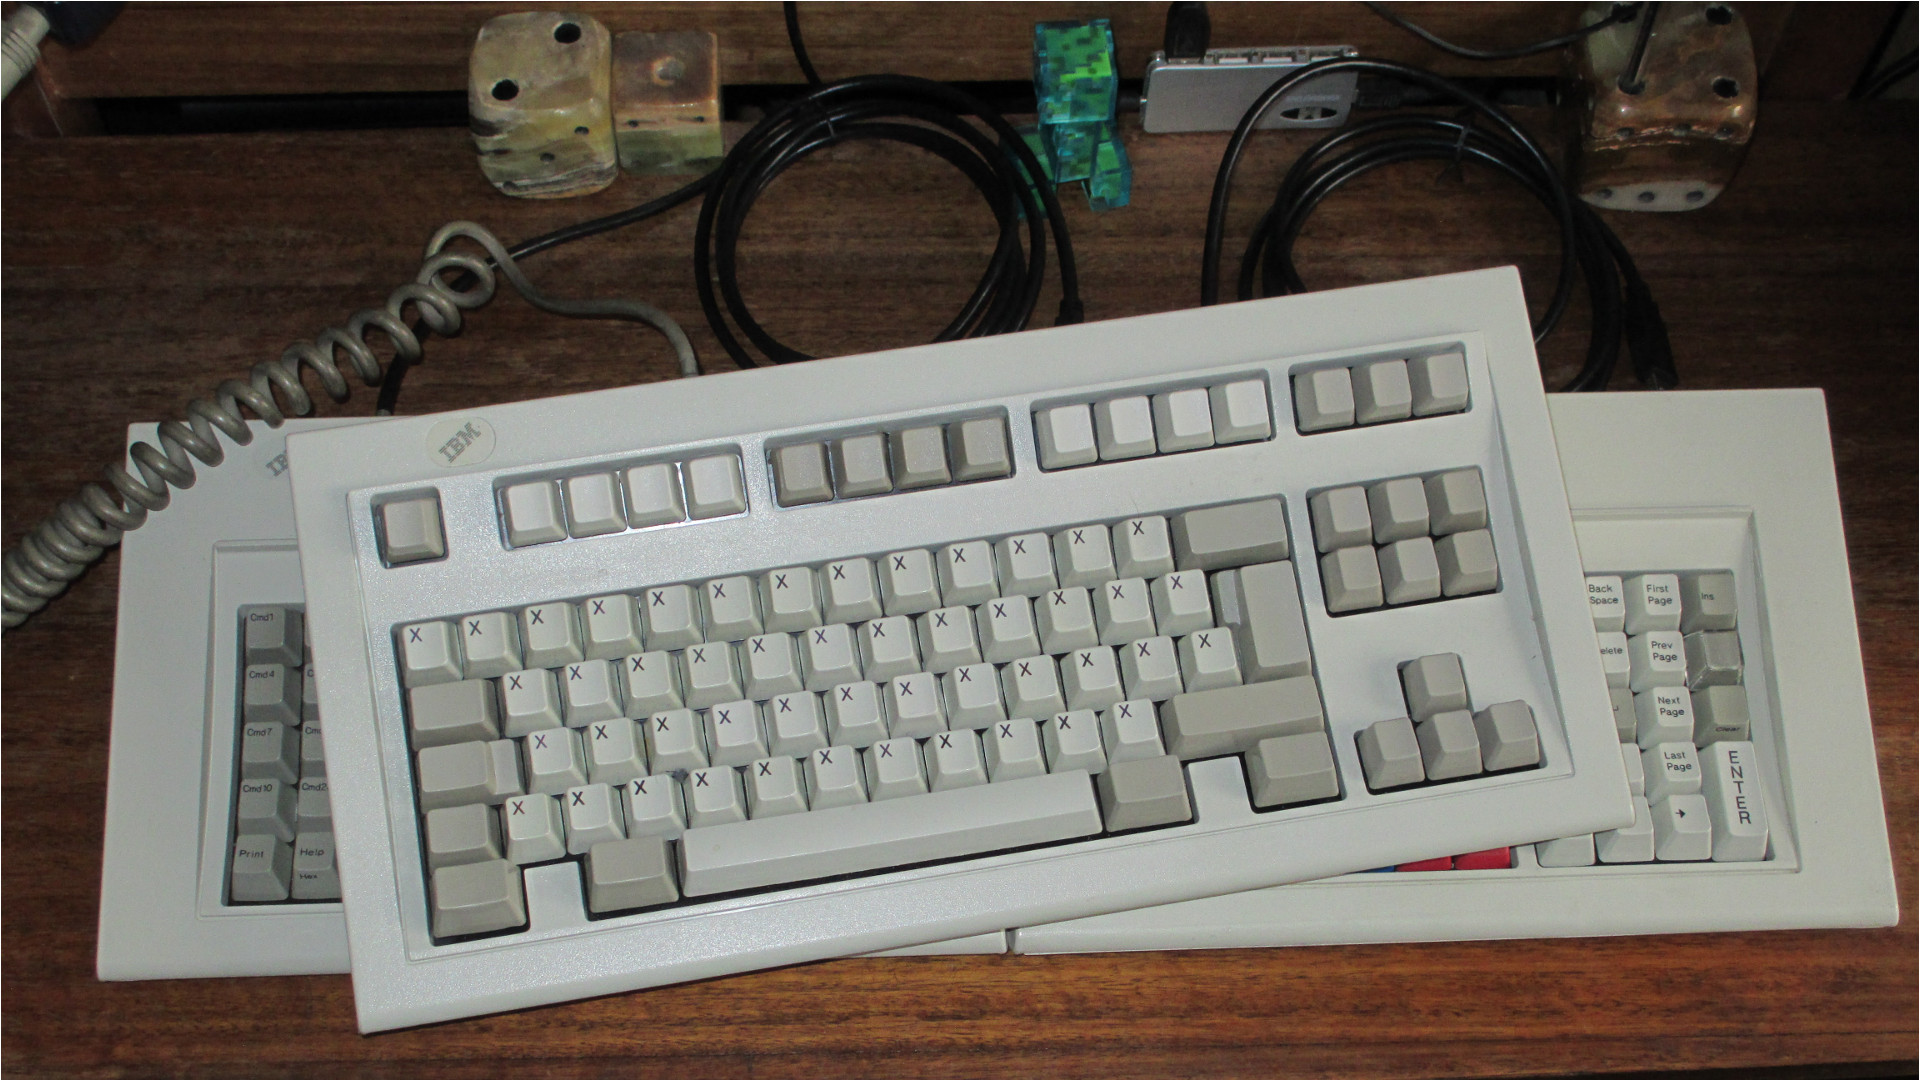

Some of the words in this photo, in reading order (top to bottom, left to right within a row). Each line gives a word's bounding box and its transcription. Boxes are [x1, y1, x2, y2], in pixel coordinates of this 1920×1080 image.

[438, 421, 481, 463] IBM
[265, 450, 288, 477] IB
[1131, 520, 1145, 536] X
[1072, 529, 1086, 545] X
[1013, 539, 1027, 555] X
[893, 555, 907, 571] X
[952, 547, 966, 564] X
[832, 564, 846, 581] X
[775, 574, 789, 590] X
[1170, 575, 1184, 590] X
[1588, 584, 1613, 594] Back
[1646, 584, 1669, 594] First
[652, 590, 665, 607] X
[712, 583, 726, 599] X
[1052, 590, 1067, 606] X
[1111, 584, 1125, 600] X
[592, 599, 606, 616] X
[1589, 595, 1619, 605] Space
[1647, 595, 1673, 606] Page
[530, 609, 544, 625] X
[993, 603, 1008, 619] X
[934, 612, 948, 628] X
[409, 627, 423, 643] X
[468, 620, 483, 637] X
[872, 622, 886, 638] X
[814, 629, 828, 645] X
[1198, 633, 1212, 649] X
[752, 637, 766, 654] X
[1137, 641, 1151, 658] X
[1651, 641, 1673, 651] Prev
[692, 647, 706, 664] X
[1080, 652, 1094, 668] X
[1652, 652, 1678, 663] Page
[631, 656, 645, 672] X
[1018, 661, 1033, 677] X
[569, 665, 583, 681] X
[958, 667, 972, 683] X
[509, 675, 523, 691] X
[899, 681, 913, 697] X
[840, 686, 854, 702] X
[1657, 696, 1680, 706] Next
[778, 697, 792, 713] X
[1118, 703, 1133, 719] X
[1659, 707, 1685, 718] Page
[655, 716, 670, 732] X
[718, 709, 732, 725] X
[1057, 715, 1072, 730] X
[594, 724, 609, 740] X
[999, 723, 1013, 739] X
[534, 734, 548, 750] X
[938, 733, 953, 749] X
[819, 749, 833, 765] X
[879, 743, 893, 759] X
[1664, 751, 1686, 760] Last
[758, 761, 772, 777] X
[1666, 762, 1692, 773] Page
[301, 782, 328, 792] Cmd2
[633, 779, 648, 796] X
[695, 771, 709, 788] X
[1728, 750, 1752, 825] ENTER
[571, 791, 585, 807] X
[512, 800, 525, 816] X
[239, 849, 264, 859] Print
[300, 848, 325, 857] Help
